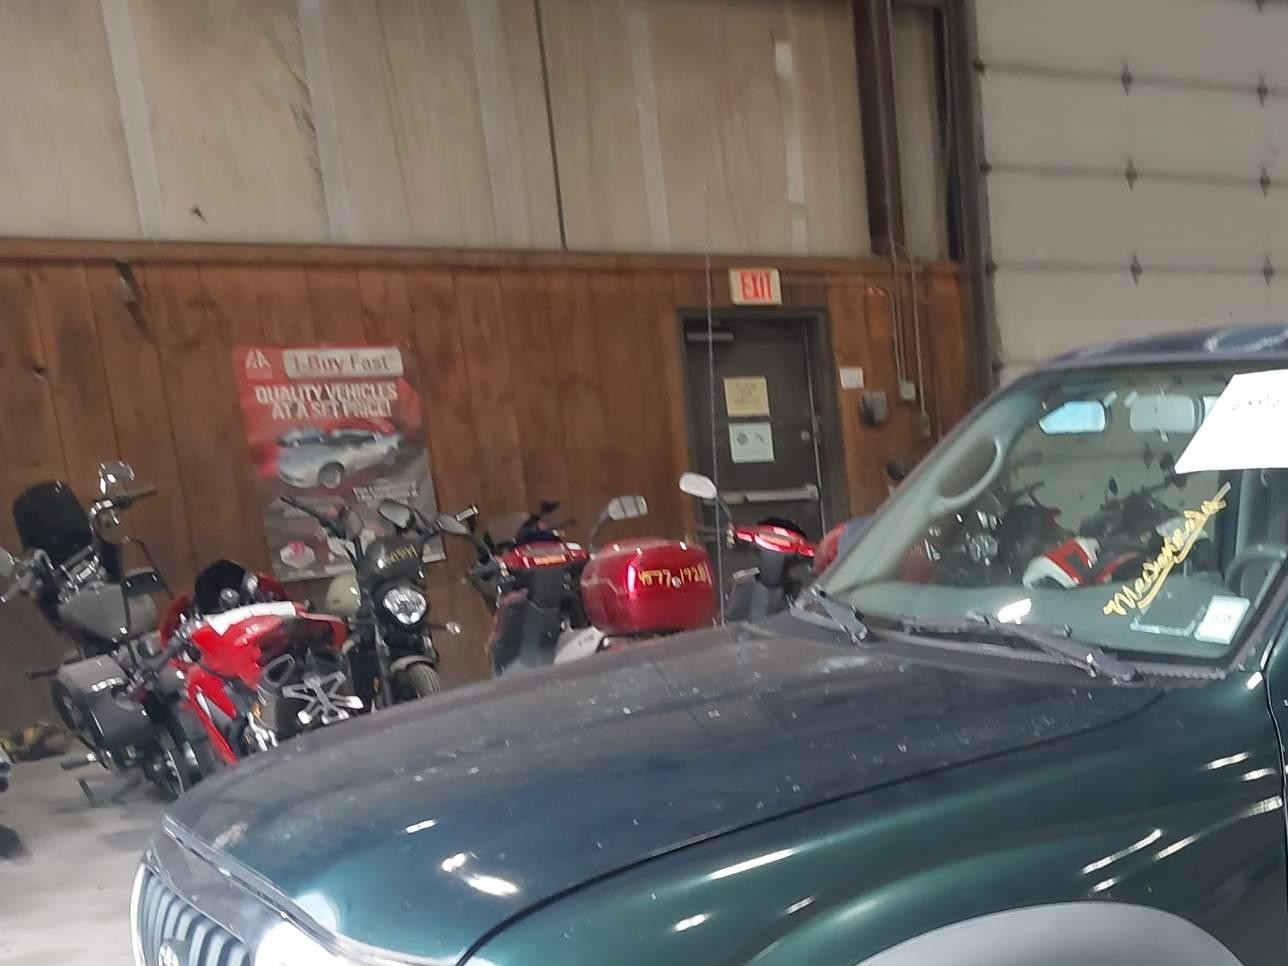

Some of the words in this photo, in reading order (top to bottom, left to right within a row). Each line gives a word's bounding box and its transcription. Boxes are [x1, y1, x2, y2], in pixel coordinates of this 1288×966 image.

[740, 271, 772, 300] EXIT
[350, 352, 391, 370] Fast
[254, 383, 323, 405] QUALITY
[324, 381, 398, 401] VEHICLES
[311, 400, 338, 418] SET
